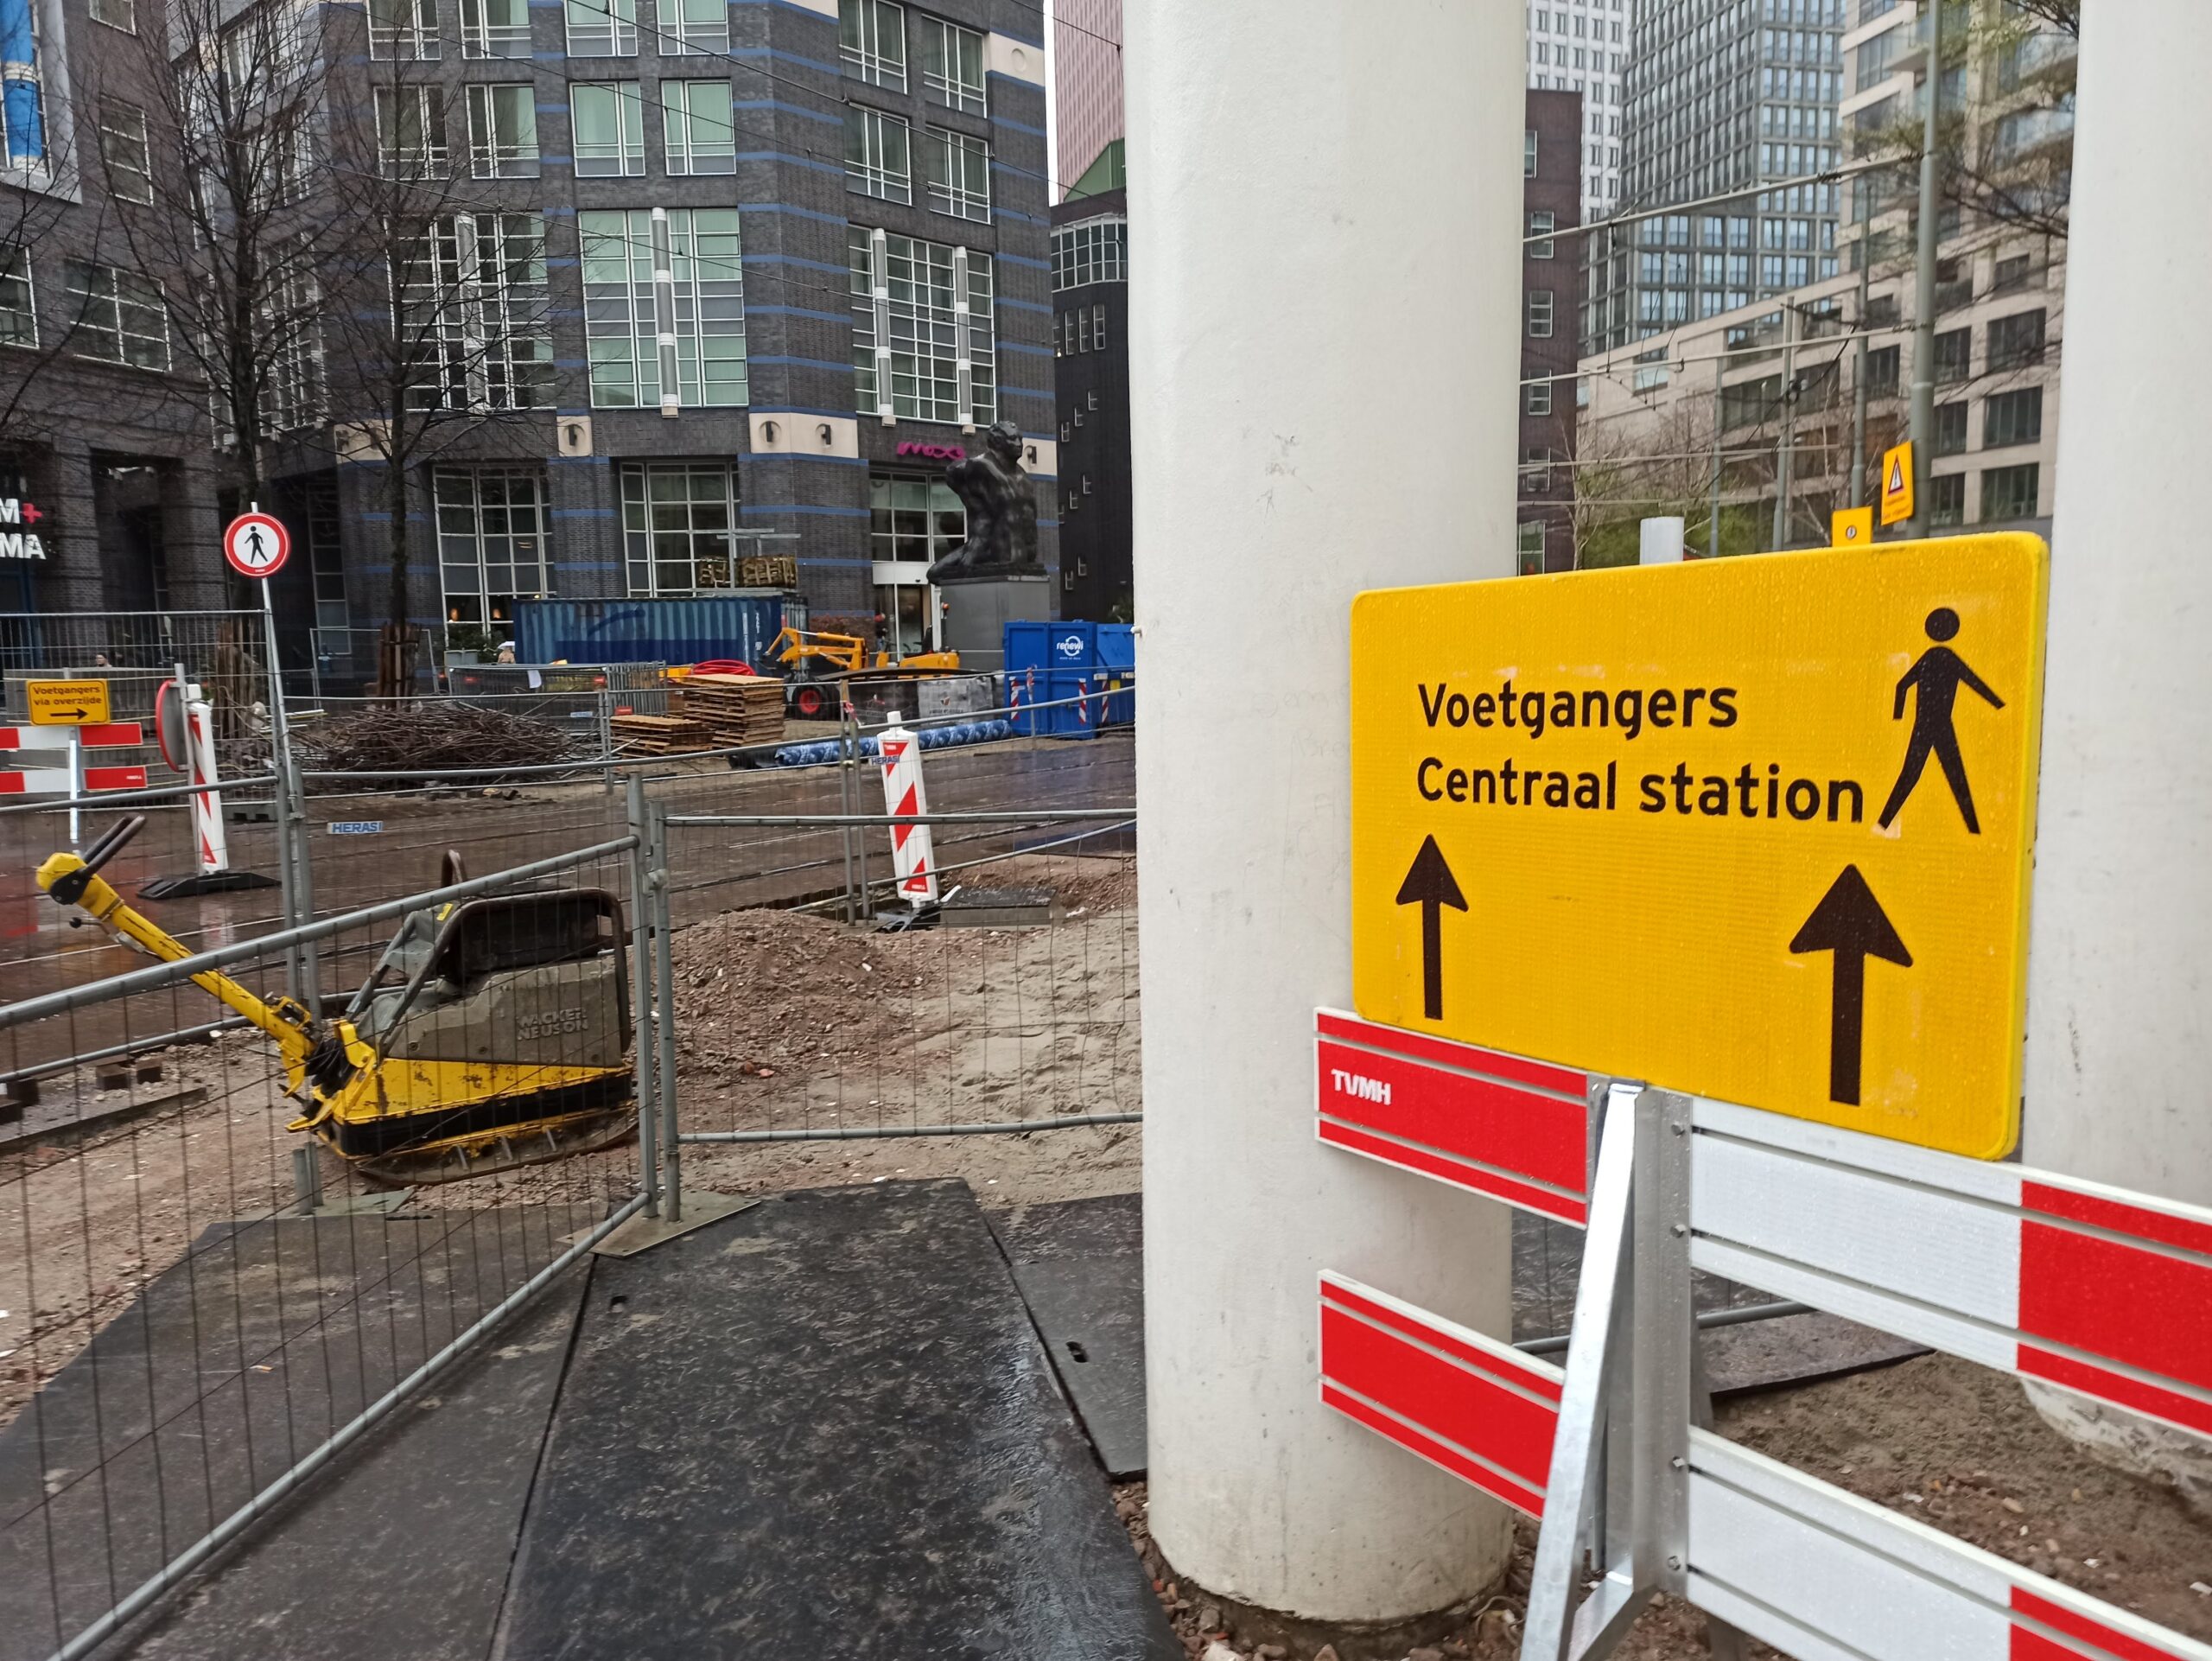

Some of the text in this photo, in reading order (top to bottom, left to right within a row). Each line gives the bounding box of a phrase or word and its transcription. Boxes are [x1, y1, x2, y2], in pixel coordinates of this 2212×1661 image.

[33, 686, 100, 695] Voetgangers
[53, 697, 102, 706] overzijde
[1417, 679, 1738, 740] Voetgangers
[1417, 757, 1618, 811] Centraal
[1639, 761, 1864, 824] station
[1331, 1068, 1391, 1106] TVMH
